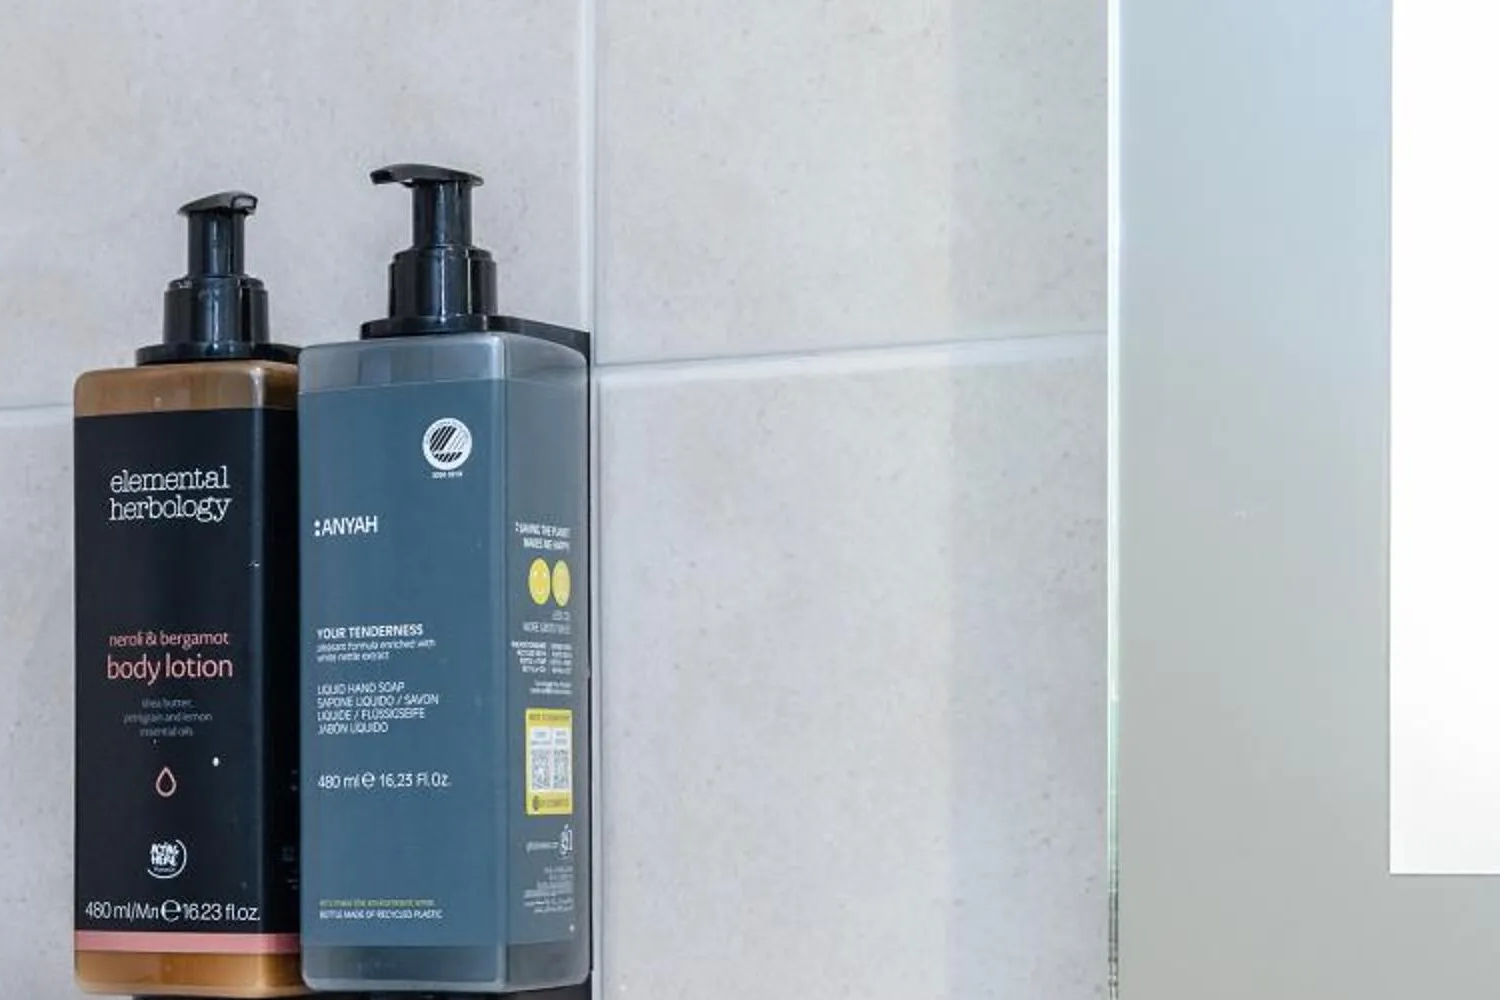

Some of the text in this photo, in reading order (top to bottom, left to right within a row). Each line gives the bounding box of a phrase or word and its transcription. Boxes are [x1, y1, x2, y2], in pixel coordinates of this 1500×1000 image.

[109, 465, 231, 494] elemental
[108, 494, 233, 523] herbology
[109, 630, 229, 650] neroli & bergamot
[316, 623, 423, 640] YOUR TENDERNESS
[107, 652, 233, 686] body lotion
[317, 681, 404, 695] LIQUID HAND SOAP
[317, 773, 341, 789] 480
[343, 773, 360, 788] ml
[85, 901, 112, 919] 480
